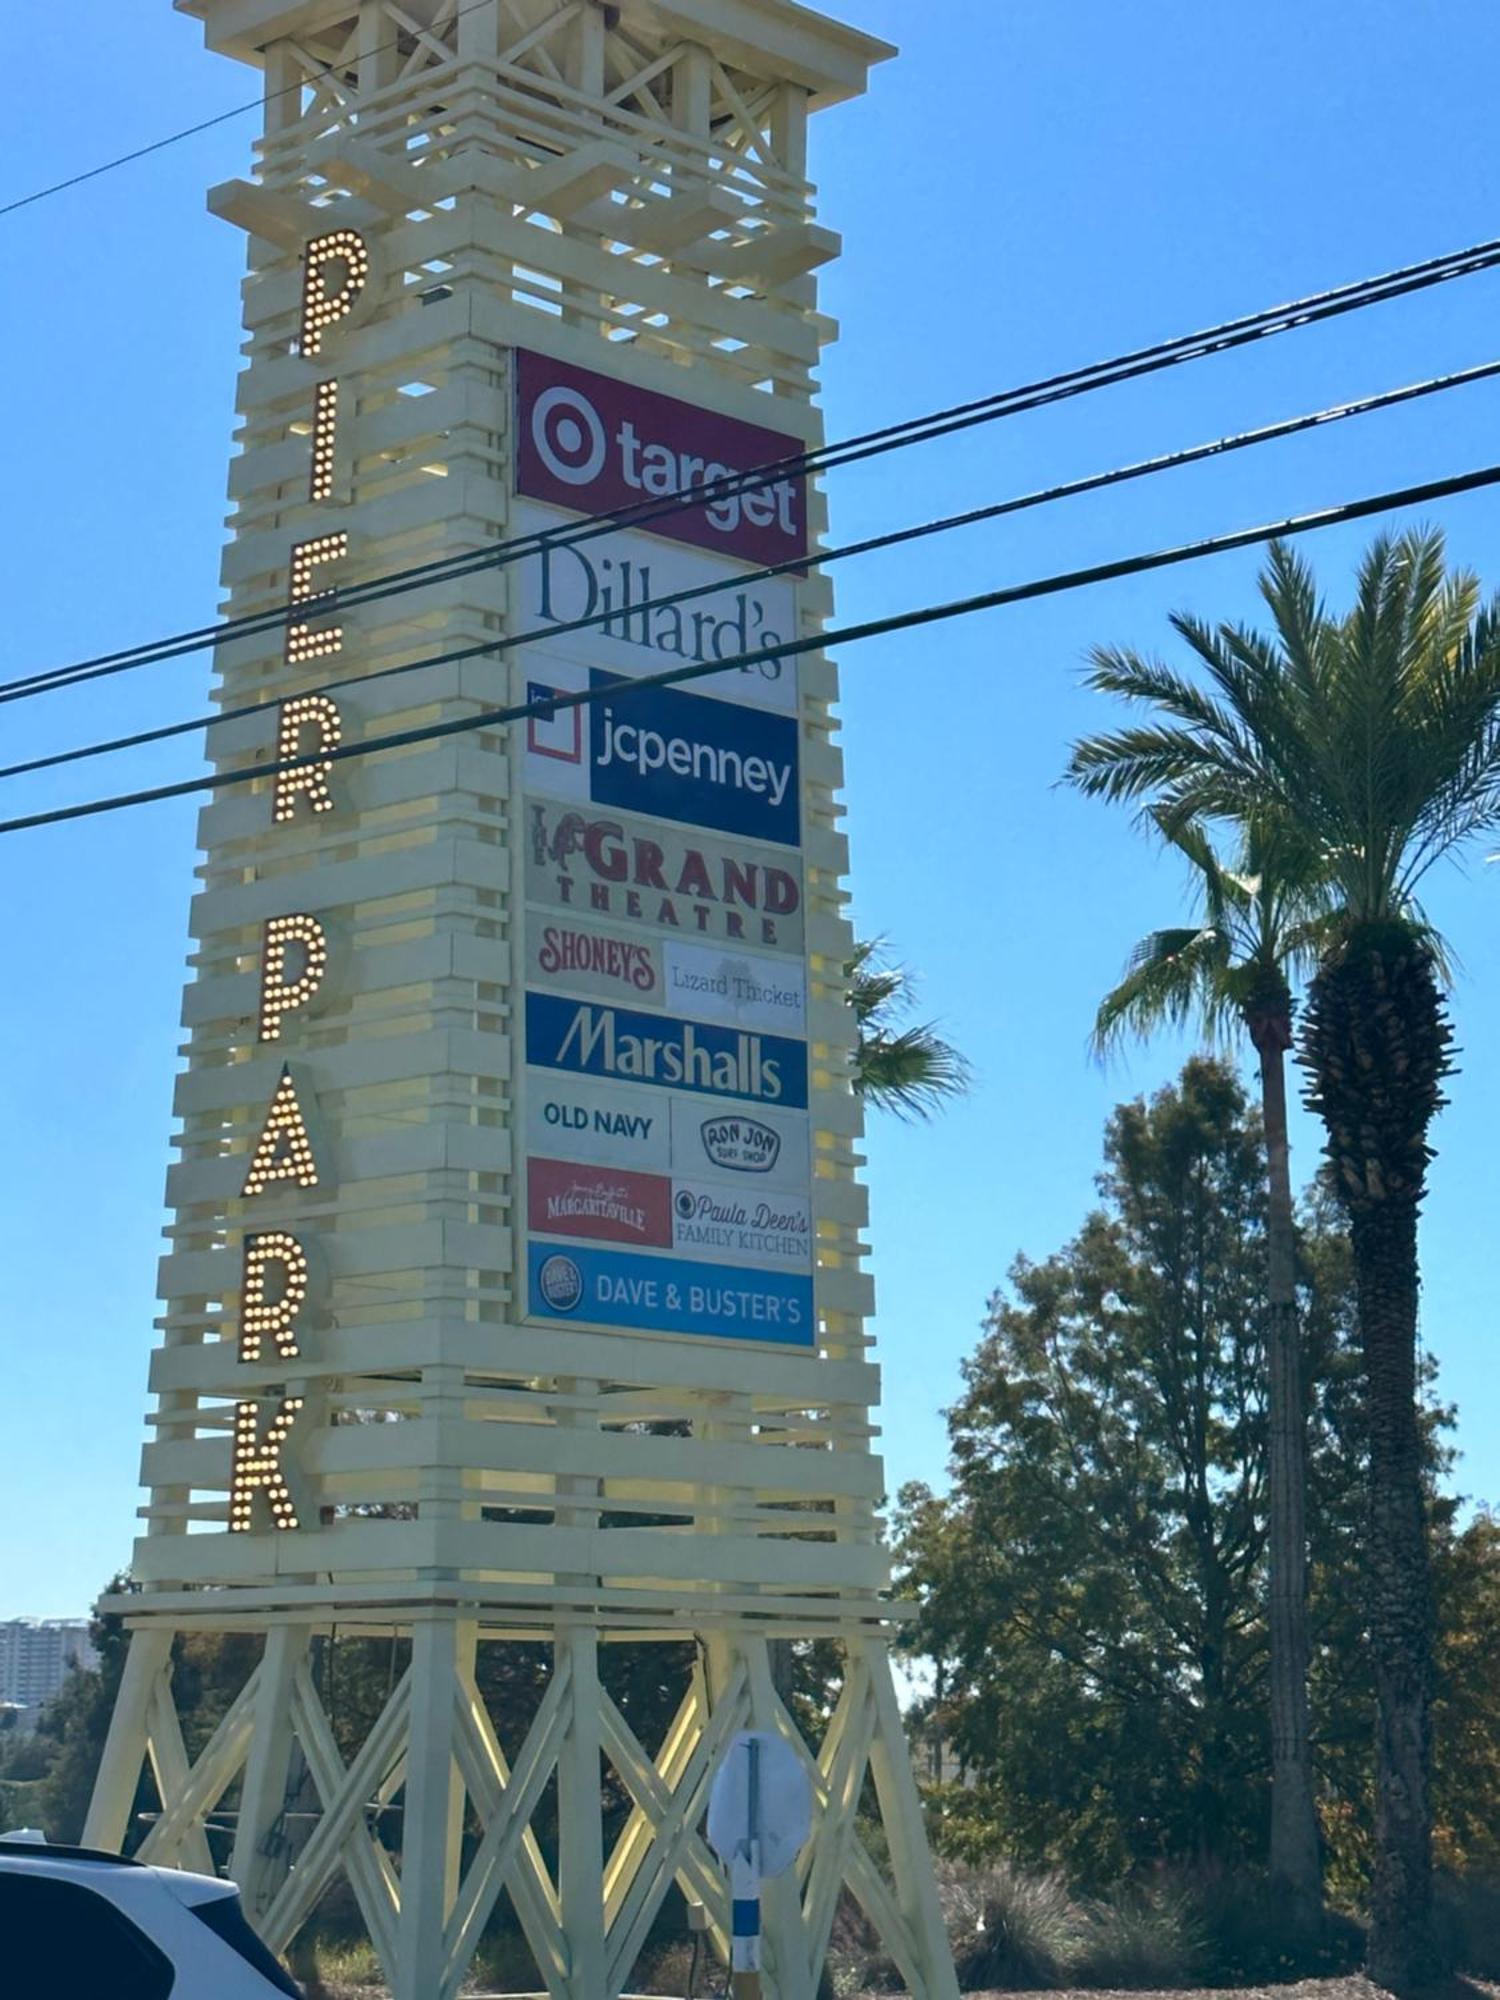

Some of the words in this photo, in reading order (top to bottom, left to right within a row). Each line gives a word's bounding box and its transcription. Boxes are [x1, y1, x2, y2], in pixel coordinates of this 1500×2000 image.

[616, 420, 797, 536] target
[273, 227, 369, 823] PIER
[535, 536, 782, 680] Dillard's
[597, 707, 791, 806] jcpenney
[583, 820, 799, 916] GRAND
[556, 875, 778, 945] THEATRE
[539, 926, 656, 992] SHONEY'S
[672, 965, 728, 995] Lizard
[555, 1006, 782, 1099] Marshalls
[544, 1102, 588, 1131] OLD
[594, 1108, 653, 1140] NAVY
[707, 1123, 740, 1147] RON
[743, 1127, 775, 1153] JON
[229, 912, 327, 1534] PARK
[677, 1222, 734, 1247] FAMILY
[738, 1230, 809, 1256] KITCHEN
[698, 1195, 747, 1226] Paula
[750, 1203, 809, 1233] Deen's
[597, 1274, 658, 1307] DAVE
[666, 1283, 682, 1311] &
[690, 1285, 802, 1324] BUSTER'S
